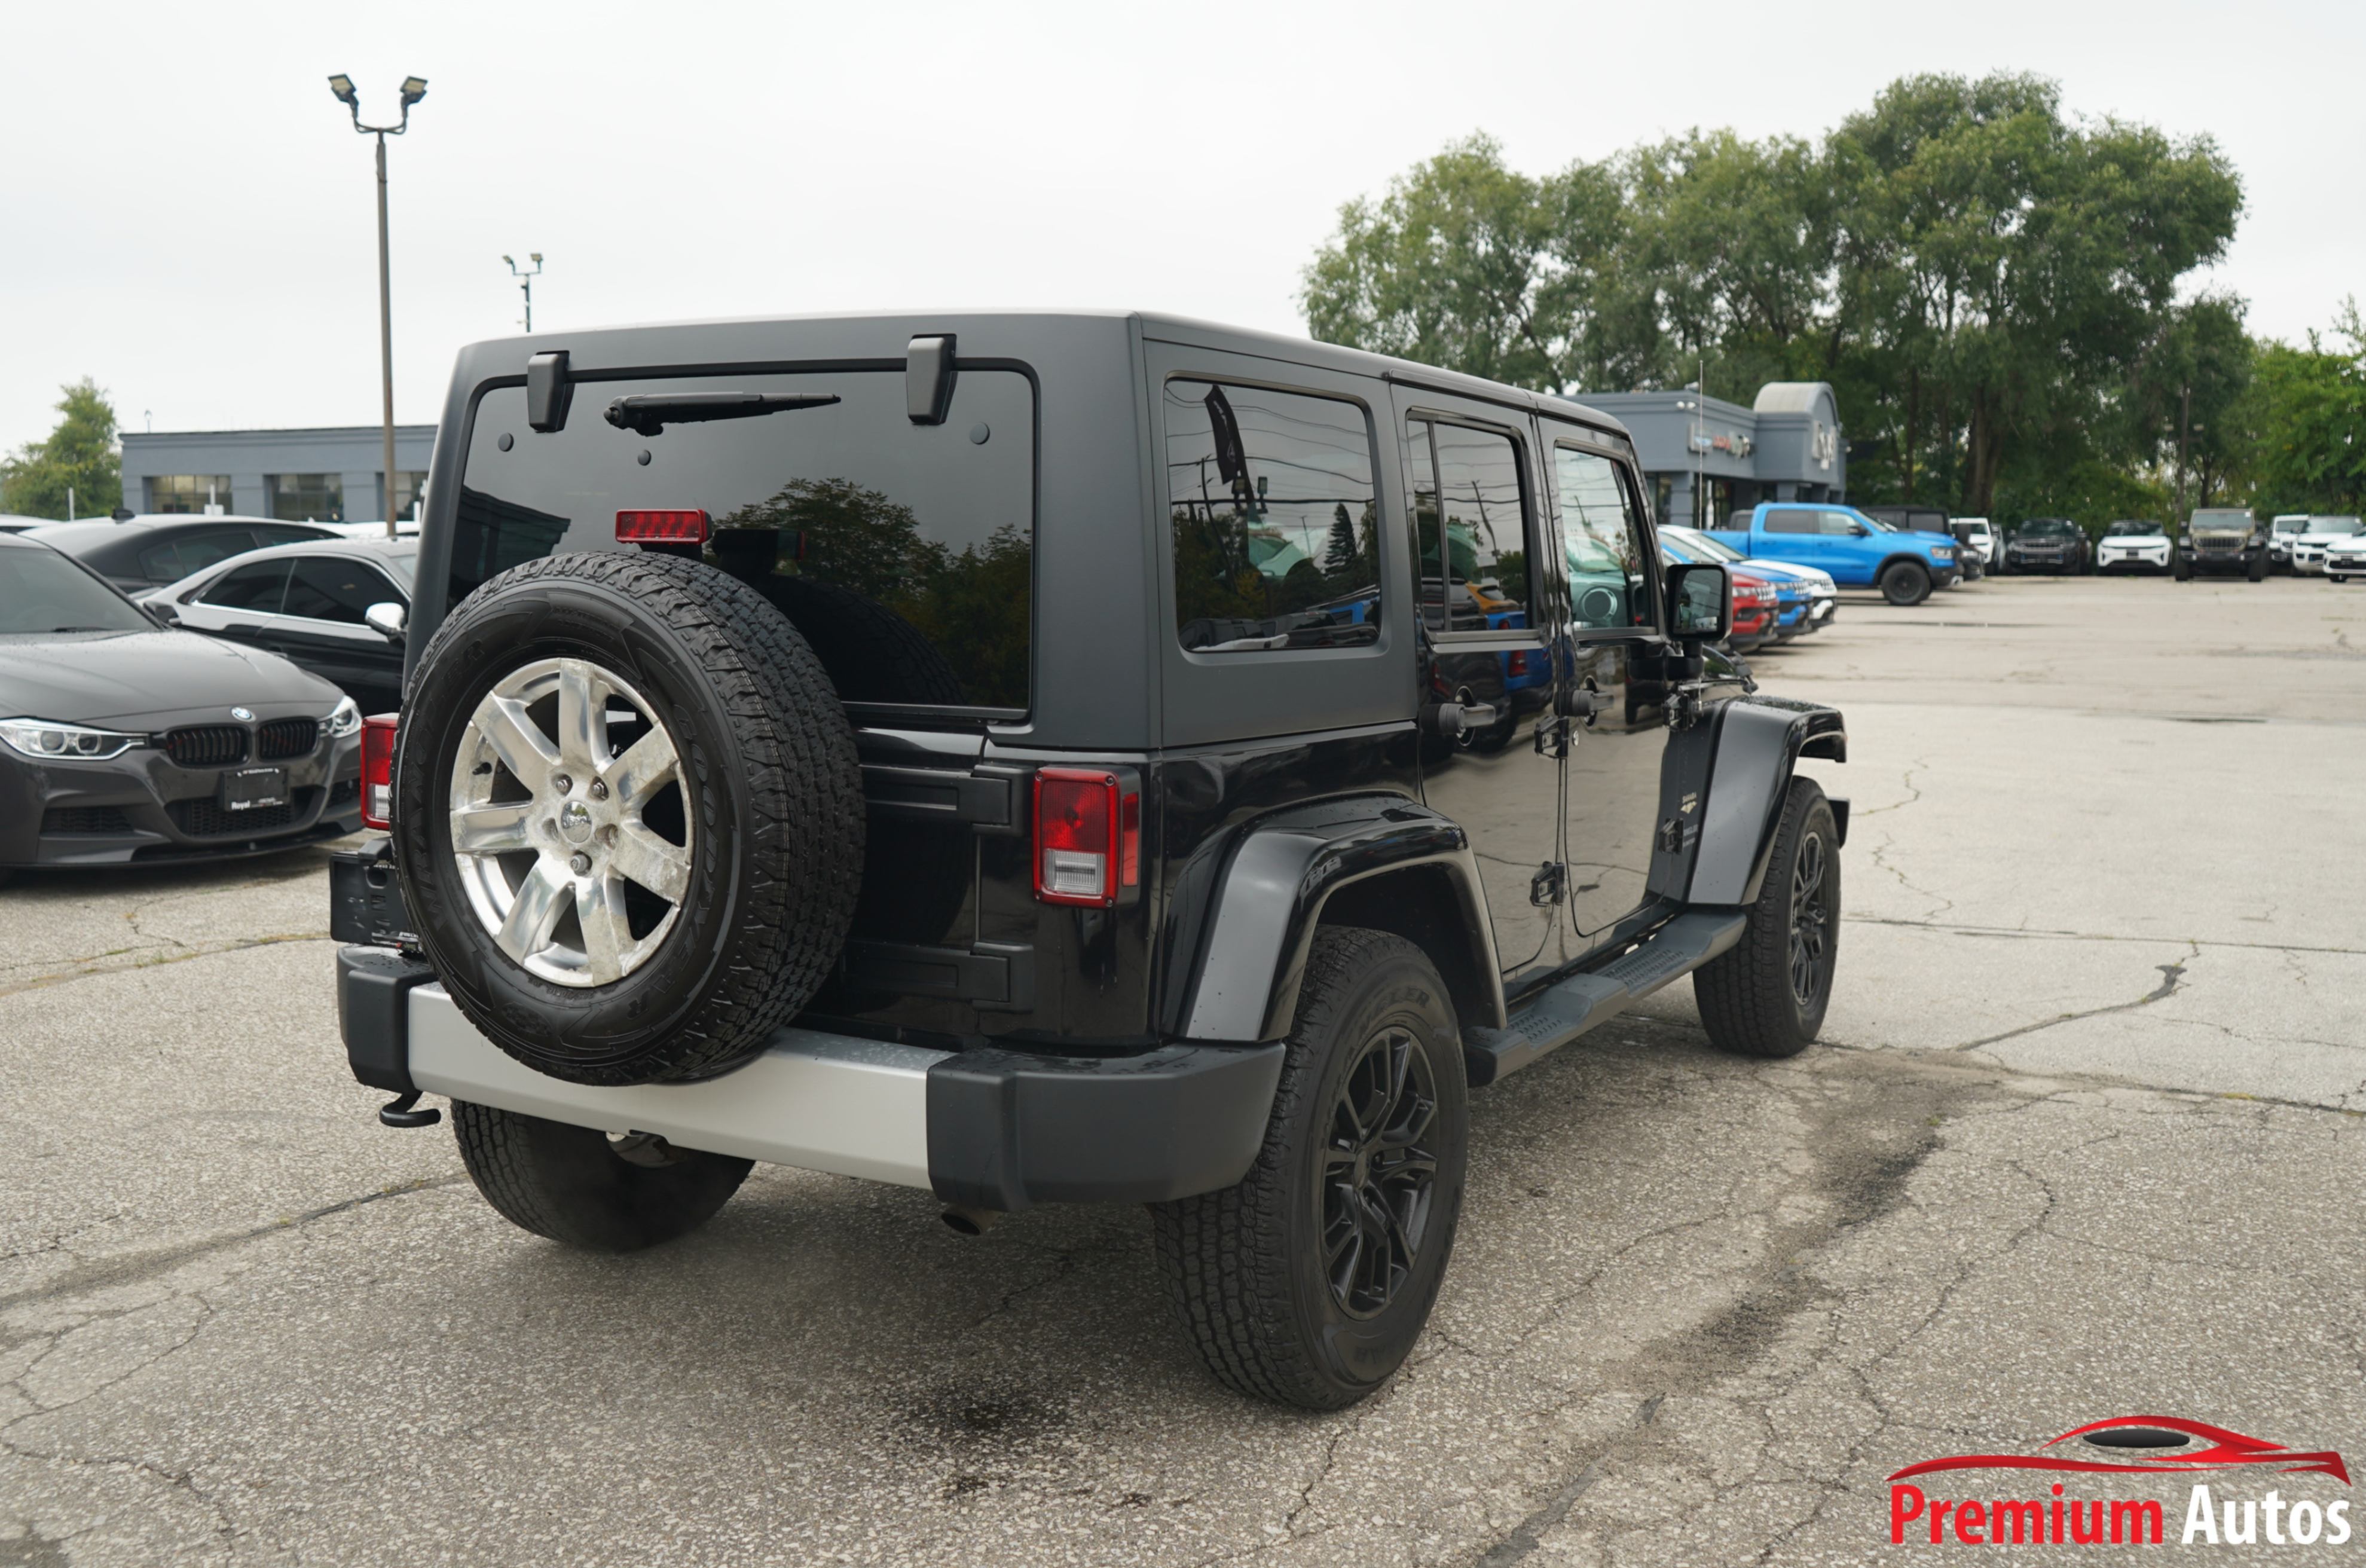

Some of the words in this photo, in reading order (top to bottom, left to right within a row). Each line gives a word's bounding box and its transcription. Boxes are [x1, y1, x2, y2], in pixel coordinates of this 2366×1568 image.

[231, 800, 250, 810] Royal
[409, 638, 486, 930] WRANGLER
[563, 814, 587, 829] Jeep
[627, 704, 718, 1020] GOODYEAR
